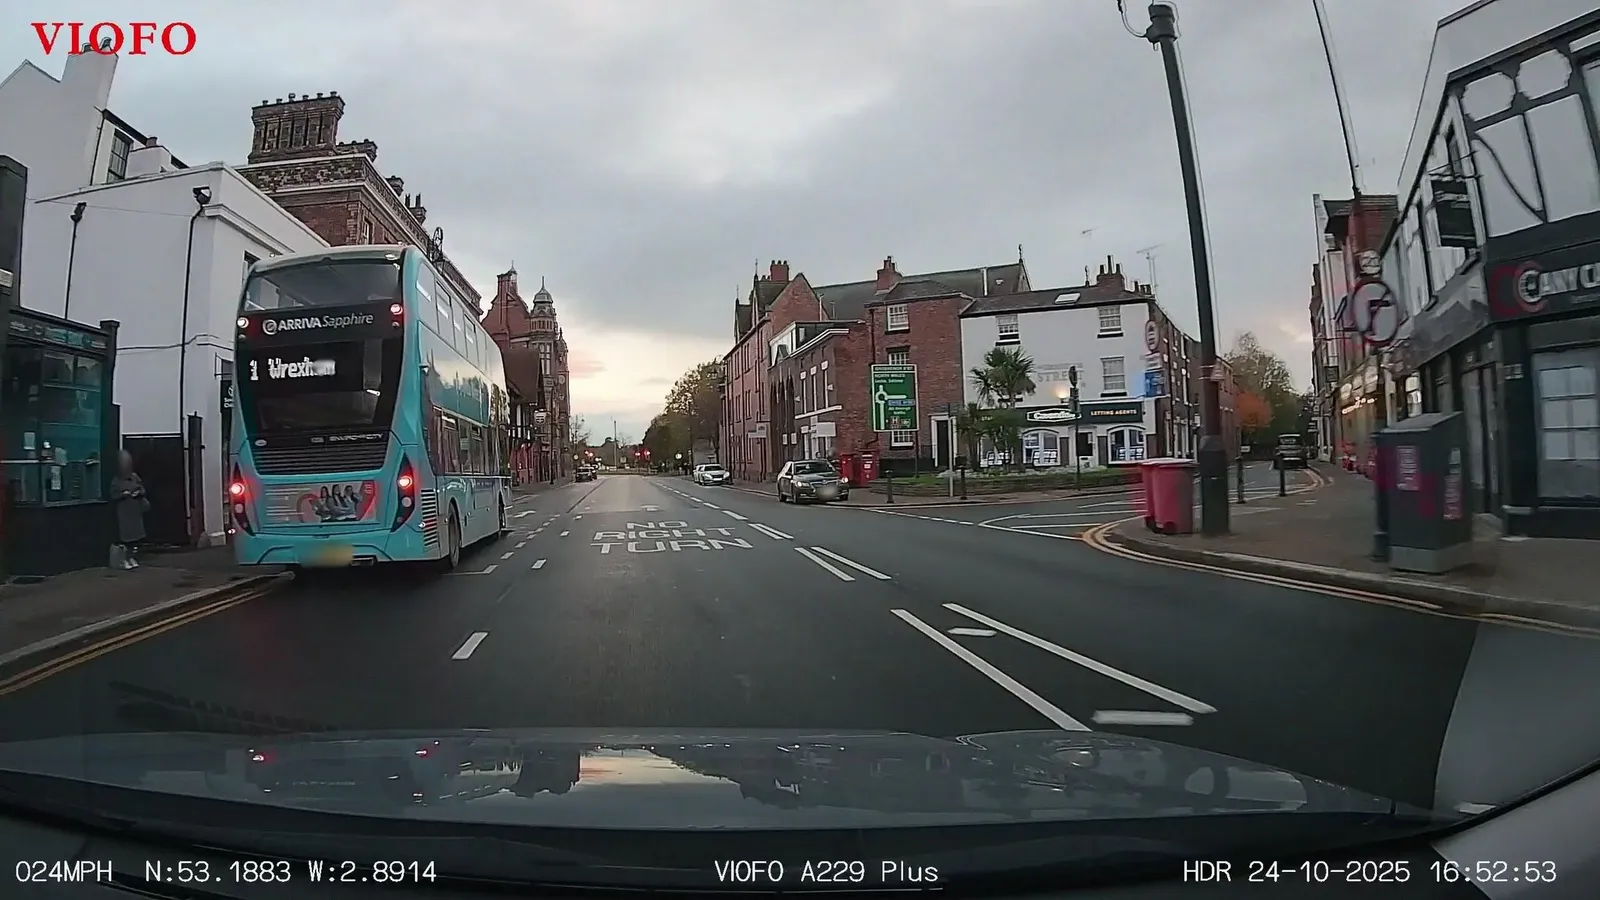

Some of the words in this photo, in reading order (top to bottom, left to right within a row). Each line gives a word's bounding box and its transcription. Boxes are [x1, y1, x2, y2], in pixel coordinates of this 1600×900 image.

[278, 317, 322, 332] ARRIVA
[322, 312, 374, 329] Sapphire
[250, 359, 259, 381] 1
[626, 520, 688, 529] NO
[593, 527, 735, 541] RIGHT
[590, 538, 754, 554] TURN
